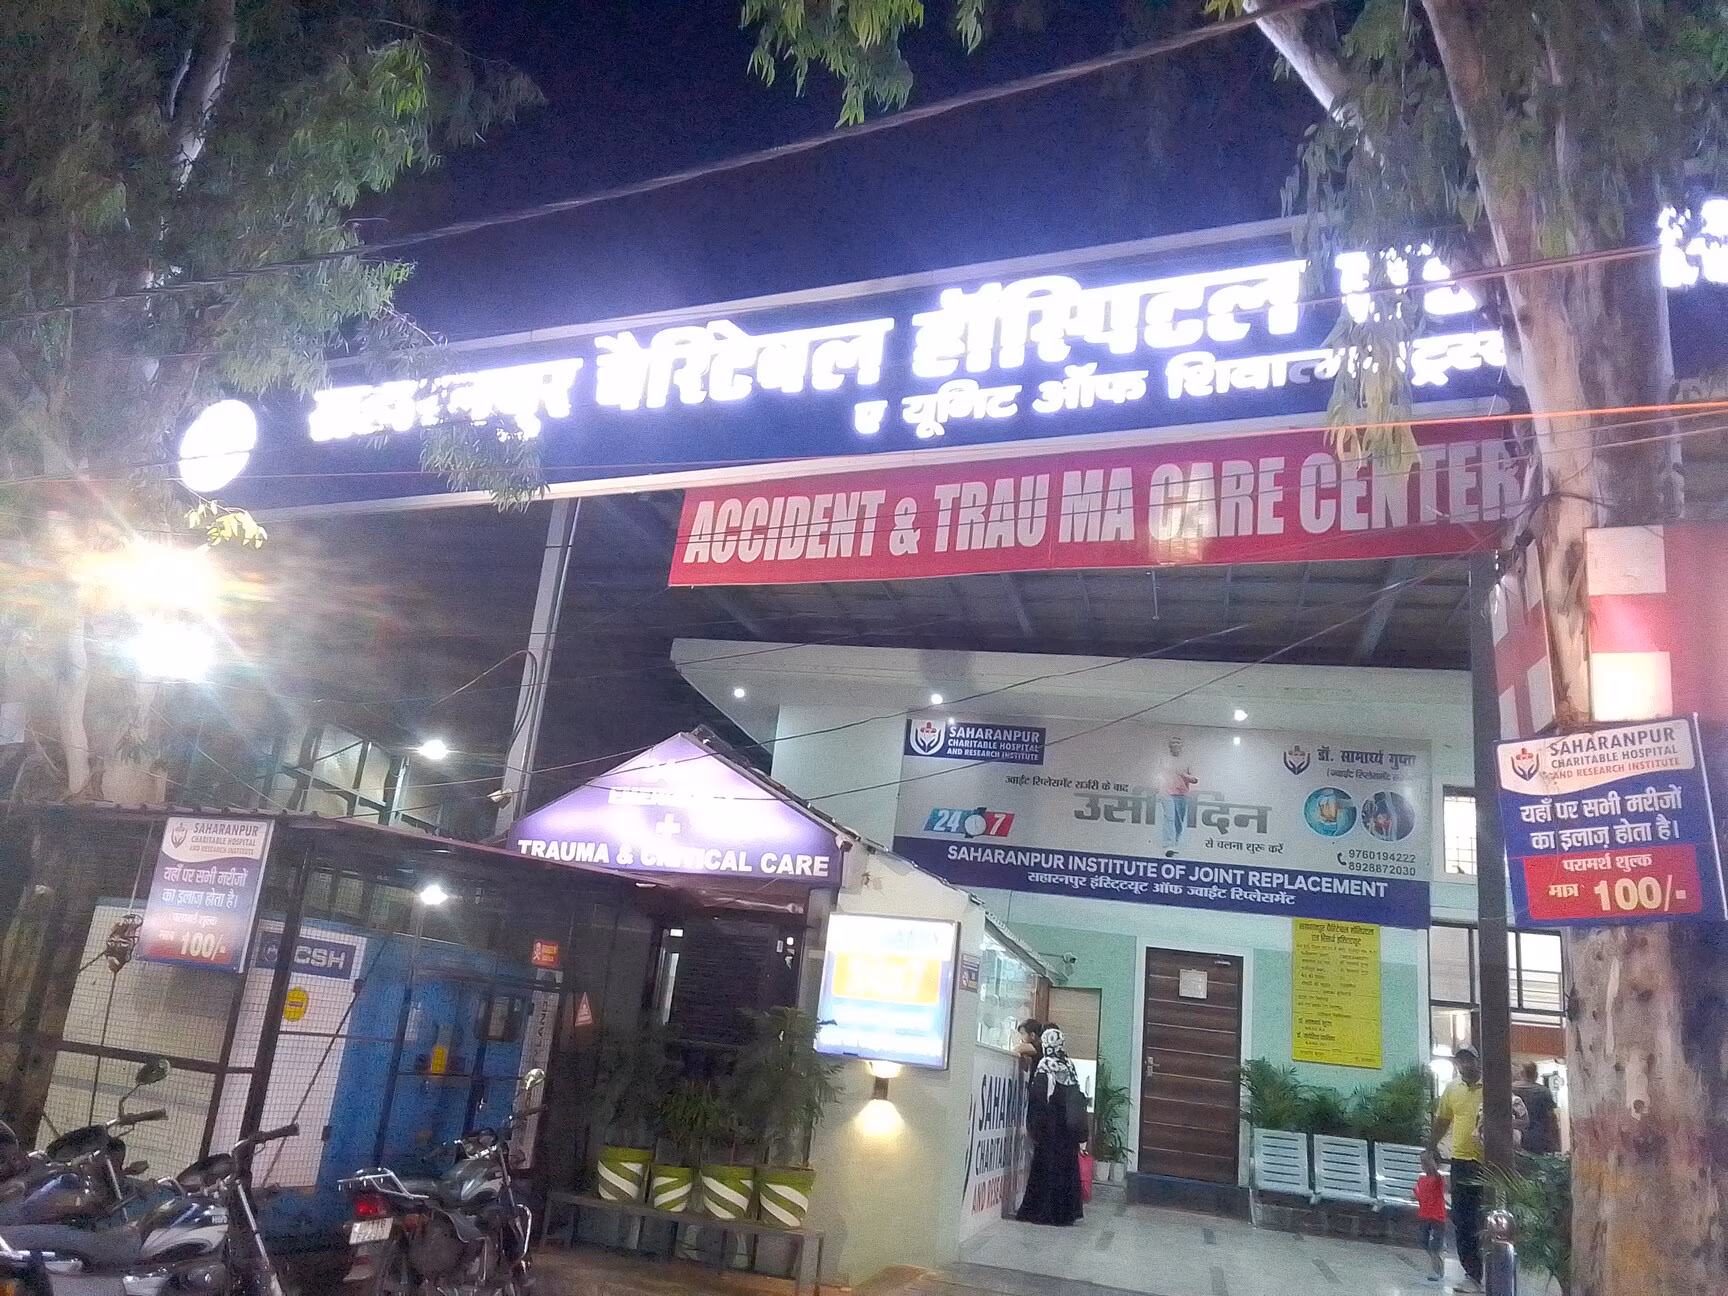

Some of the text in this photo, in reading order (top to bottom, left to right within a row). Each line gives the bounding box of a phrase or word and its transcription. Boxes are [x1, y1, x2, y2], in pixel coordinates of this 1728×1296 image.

[1032, 362, 1149, 415] ऑफ
[683, 489, 887, 564] ACCIDENT
[889, 497, 920, 556] &
[1148, 456, 1285, 542] CARE
[1300, 437, 1523, 534] CENTER
[947, 739, 1039, 753] CHARITABLE HOSPITAL
[949, 726, 1040, 743] SAHARANPUR
[1549, 727, 1676, 757] SAHARANPUR
[946, 748, 1039, 761] AND RESEARCH INSTITUTE
[1551, 744, 1678, 769] CHARITABLE HOSPITAL
[1553, 757, 1680, 780] AND RESEARCH INSTITUTE
[1186, 789, 1273, 835] दिन
[1520, 797, 1553, 824] यहाँ
[1555, 800, 1579, 820] पर
[1582, 790, 1621, 818] सभी
[193, 822, 260, 837] SAHARANPUR
[933, 809, 1007, 836] 24 7
[1530, 831, 1555, 850] का
[1613, 817, 1651, 844] होता
[1205, 837, 1214, 849] से
[1348, 849, 1416, 864] 9760194222
[517, 839, 610, 864] TRAUMA
[616, 842, 634, 865] &
[760, 852, 830, 877] CARE
[948, 845, 1389, 898] SAHARANPUR INSTITUTE OF JOINT REPLACEMENT
[1562, 852, 1653, 873] परामर्श शुल्क
[182, 868, 196, 883] पर
[196, 865, 217, 885] सभी
[1027, 871, 1087, 889] सहारनपुर
[1152, 880, 1183, 895] ऑफ
[1230, 886, 1297, 905] रिप्लेसमेंट
[162, 888, 177, 902] का
[1549, 874, 1687, 912] मात्र 100/-
[180, 931, 226, 961] 100/-
